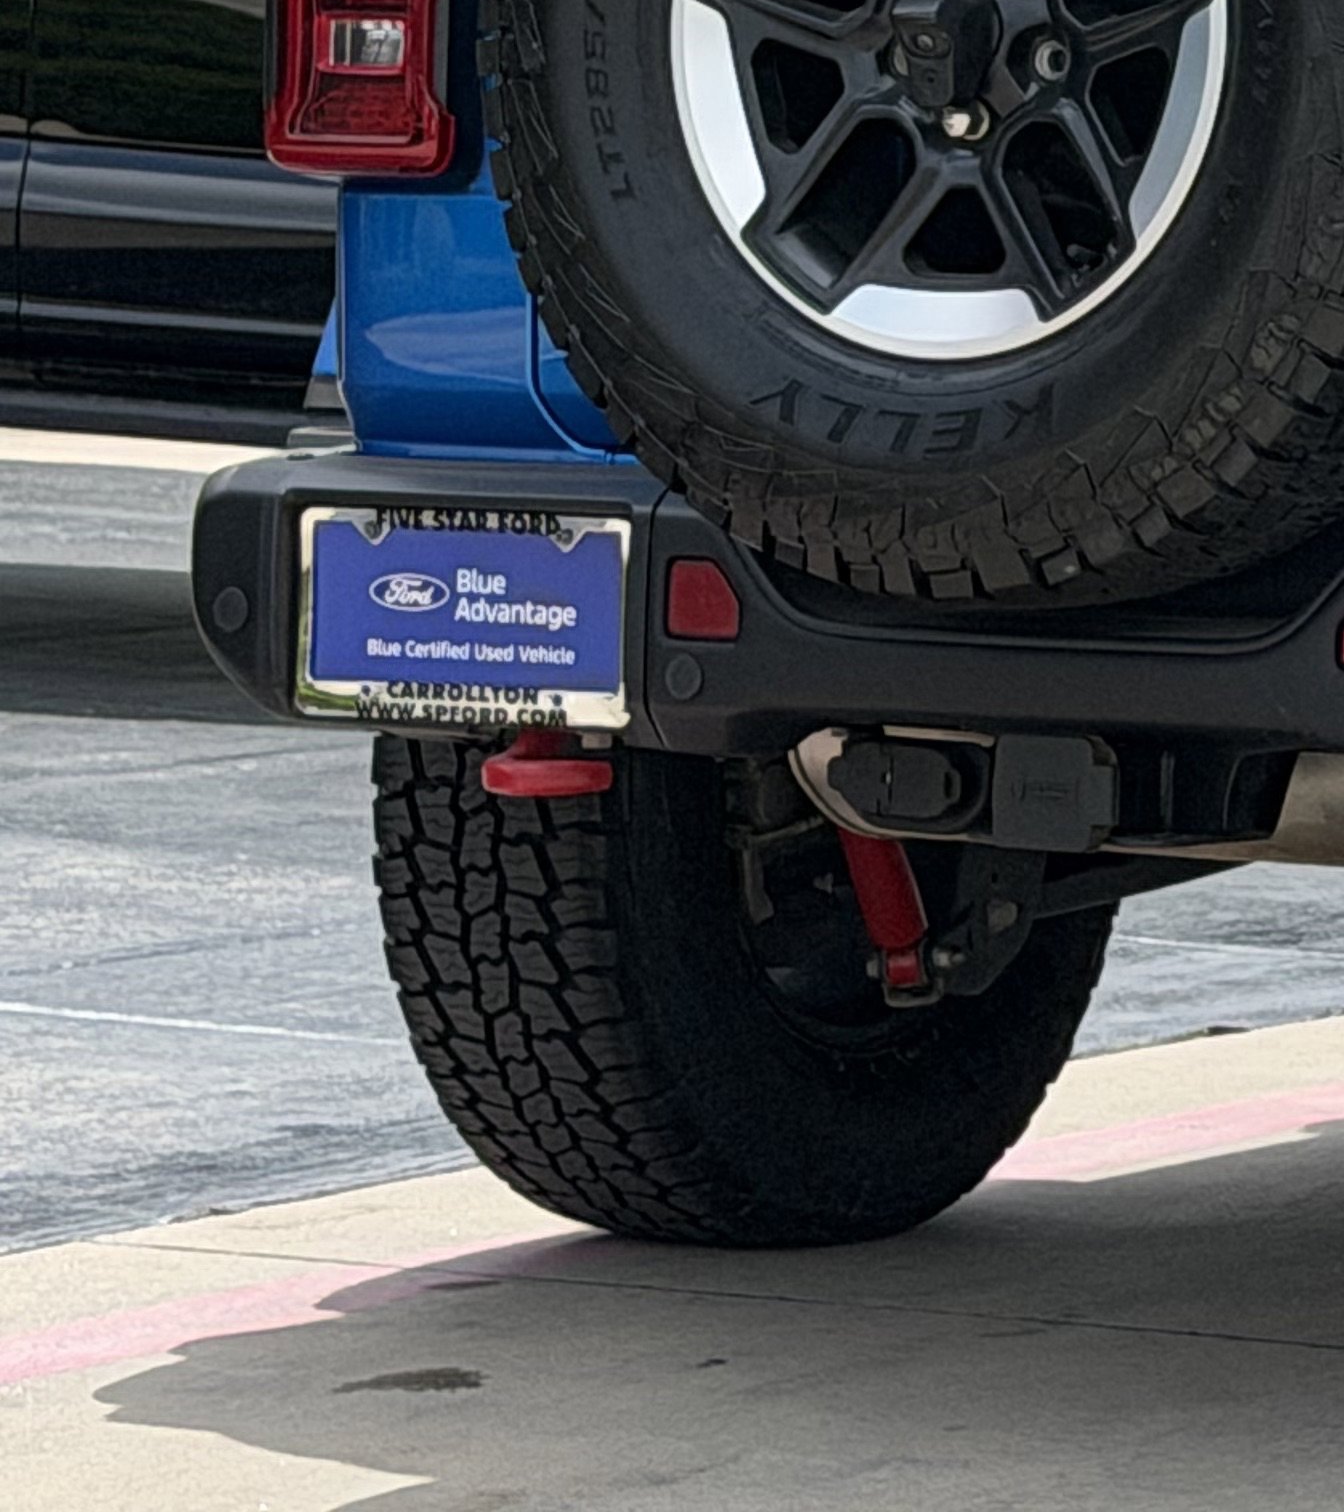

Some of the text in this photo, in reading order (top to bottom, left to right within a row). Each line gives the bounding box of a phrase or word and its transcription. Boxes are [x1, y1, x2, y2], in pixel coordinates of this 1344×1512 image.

[750, 378, 1056, 456] KELLY
[377, 506, 561, 537] FIVE STAR FORD
[384, 577, 435, 606] Ford
[456, 568, 507, 595] Blue
[454, 597, 578, 632] Advantage
[366, 638, 576, 666] Blue Certified Used Vehicle
[386, 680, 539, 706] CARROLLTON
